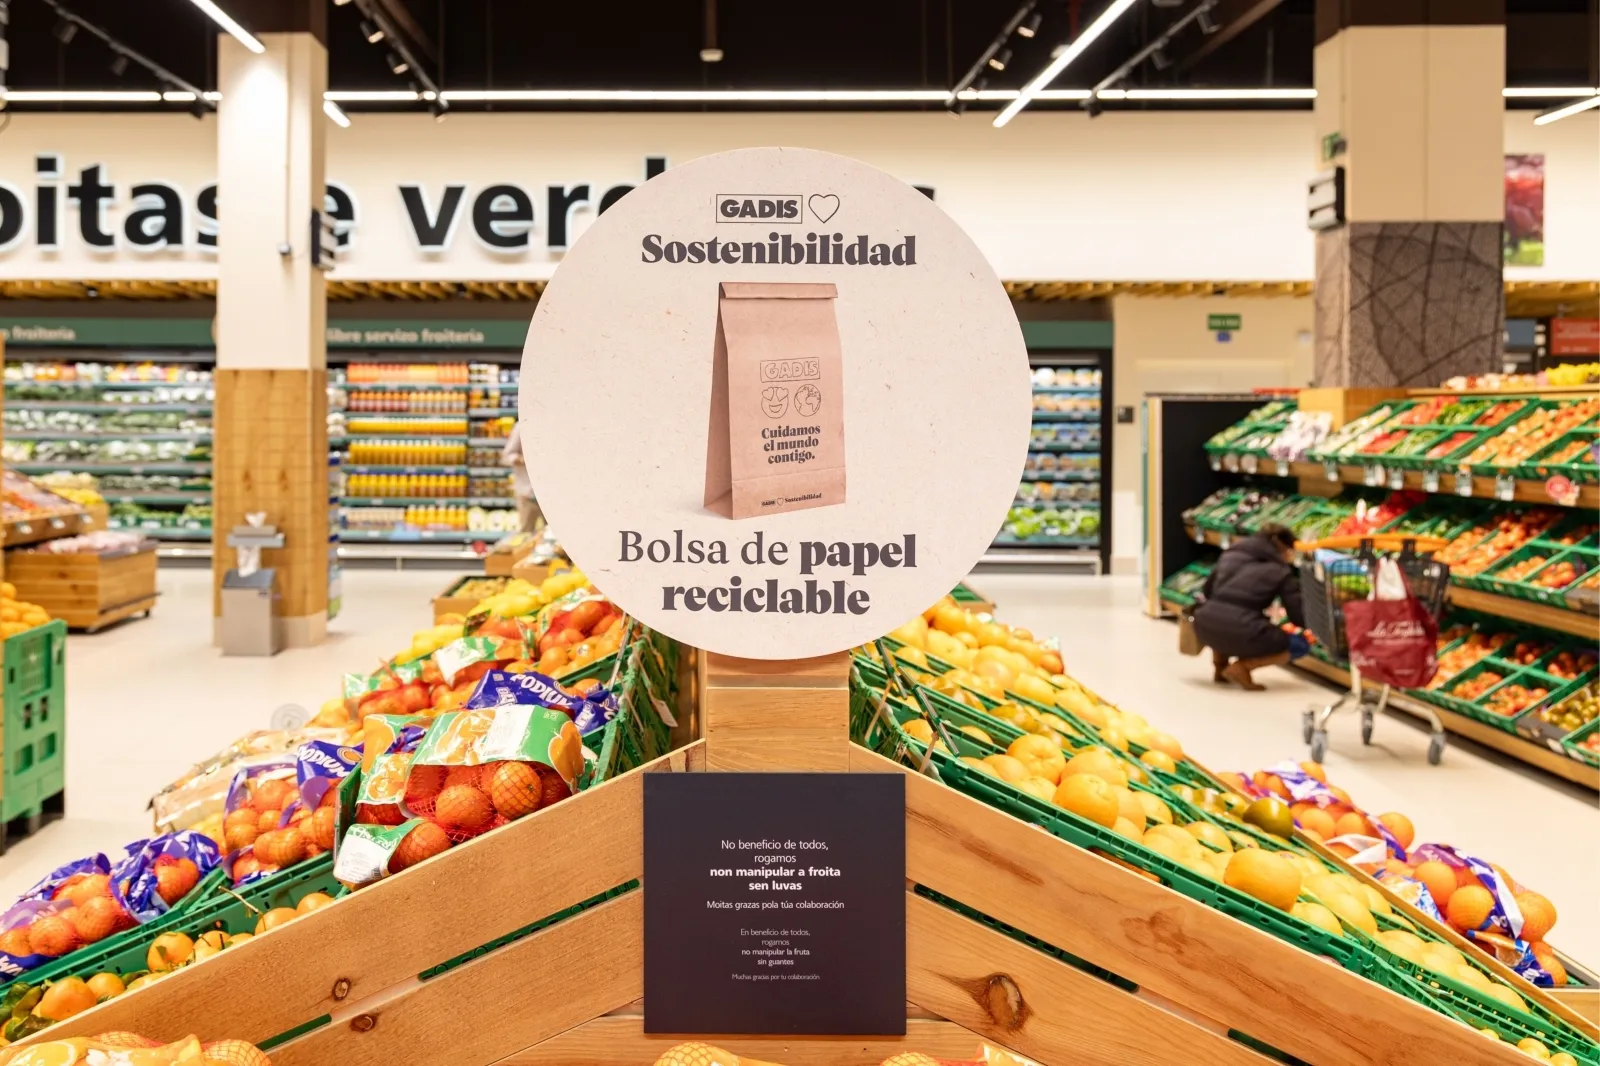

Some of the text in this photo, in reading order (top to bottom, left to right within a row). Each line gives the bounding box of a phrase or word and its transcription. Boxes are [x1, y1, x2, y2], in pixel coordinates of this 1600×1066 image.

[719, 198, 800, 220] GADIS
[641, 232, 917, 266] Sostenibilidad
[764, 361, 819, 379] GADIS
[761, 425, 821, 440] Cuidamos
[763, 436, 819, 452] el mundo
[767, 449, 816, 464] contigo.
[784, 493, 822, 503] Sostenibilidad
[618, 530, 918, 576] Bolsa de papel
[661, 576, 871, 615] reciclable
[721, 839, 829, 851] No beneficio de todos,
[754, 854, 797, 865] rogamos
[709, 866, 841, 878] non manipular a froita
[748, 880, 803, 890] sen luvas
[706, 900, 845, 911] Moitas grazas pola túa colaboración
[740, 928, 811, 937] En beneficio de todos,
[761, 940, 790, 948] rogamos
[752, 947, 785, 957] manipular
[786, 948, 793, 956] la
[793, 948, 811, 956] fruta
[768, 959, 795, 967] guantes
